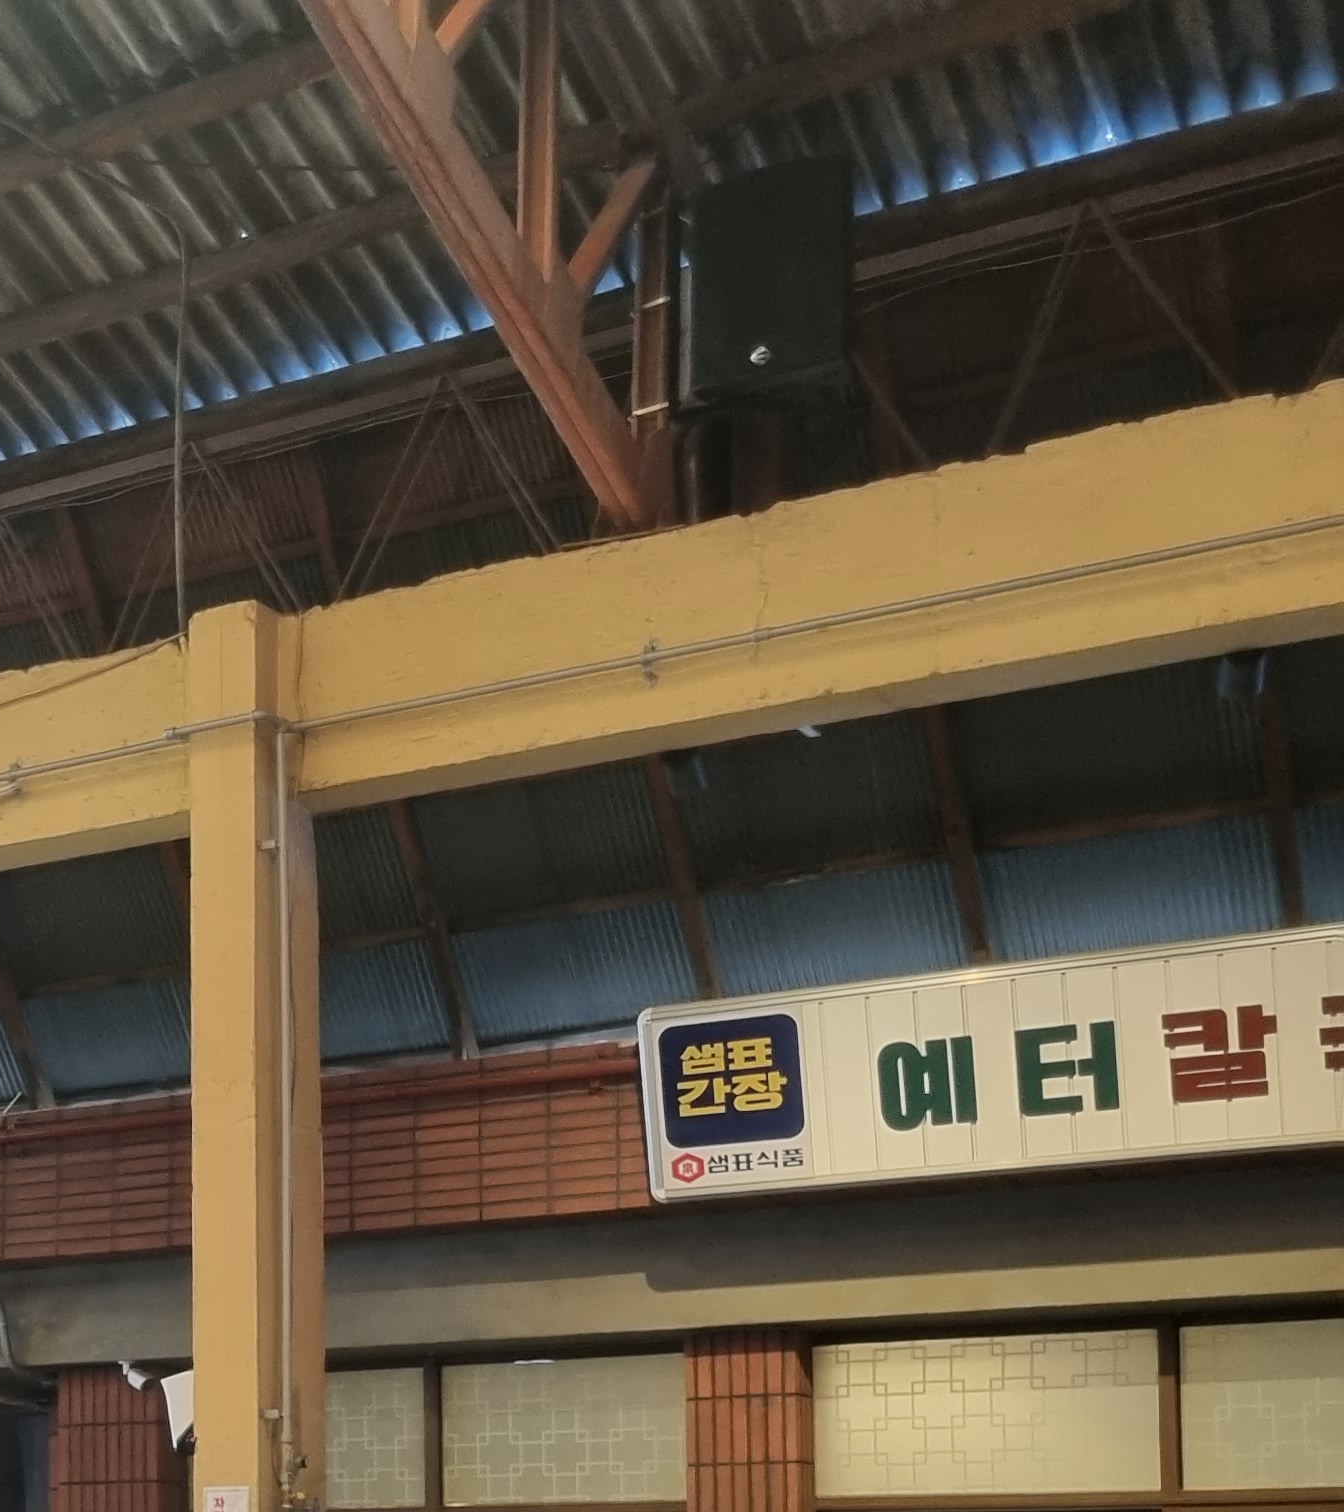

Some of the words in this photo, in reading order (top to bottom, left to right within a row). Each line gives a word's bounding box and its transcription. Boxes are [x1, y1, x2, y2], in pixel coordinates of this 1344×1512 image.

[679, 1036, 772, 1077] 샘표
[876, 1020, 1120, 1132] 예터
[1160, 996, 1344, 1103] 칼
[676, 1073, 787, 1118] 간장
[707, 1147, 805, 1174] 샘표식품
